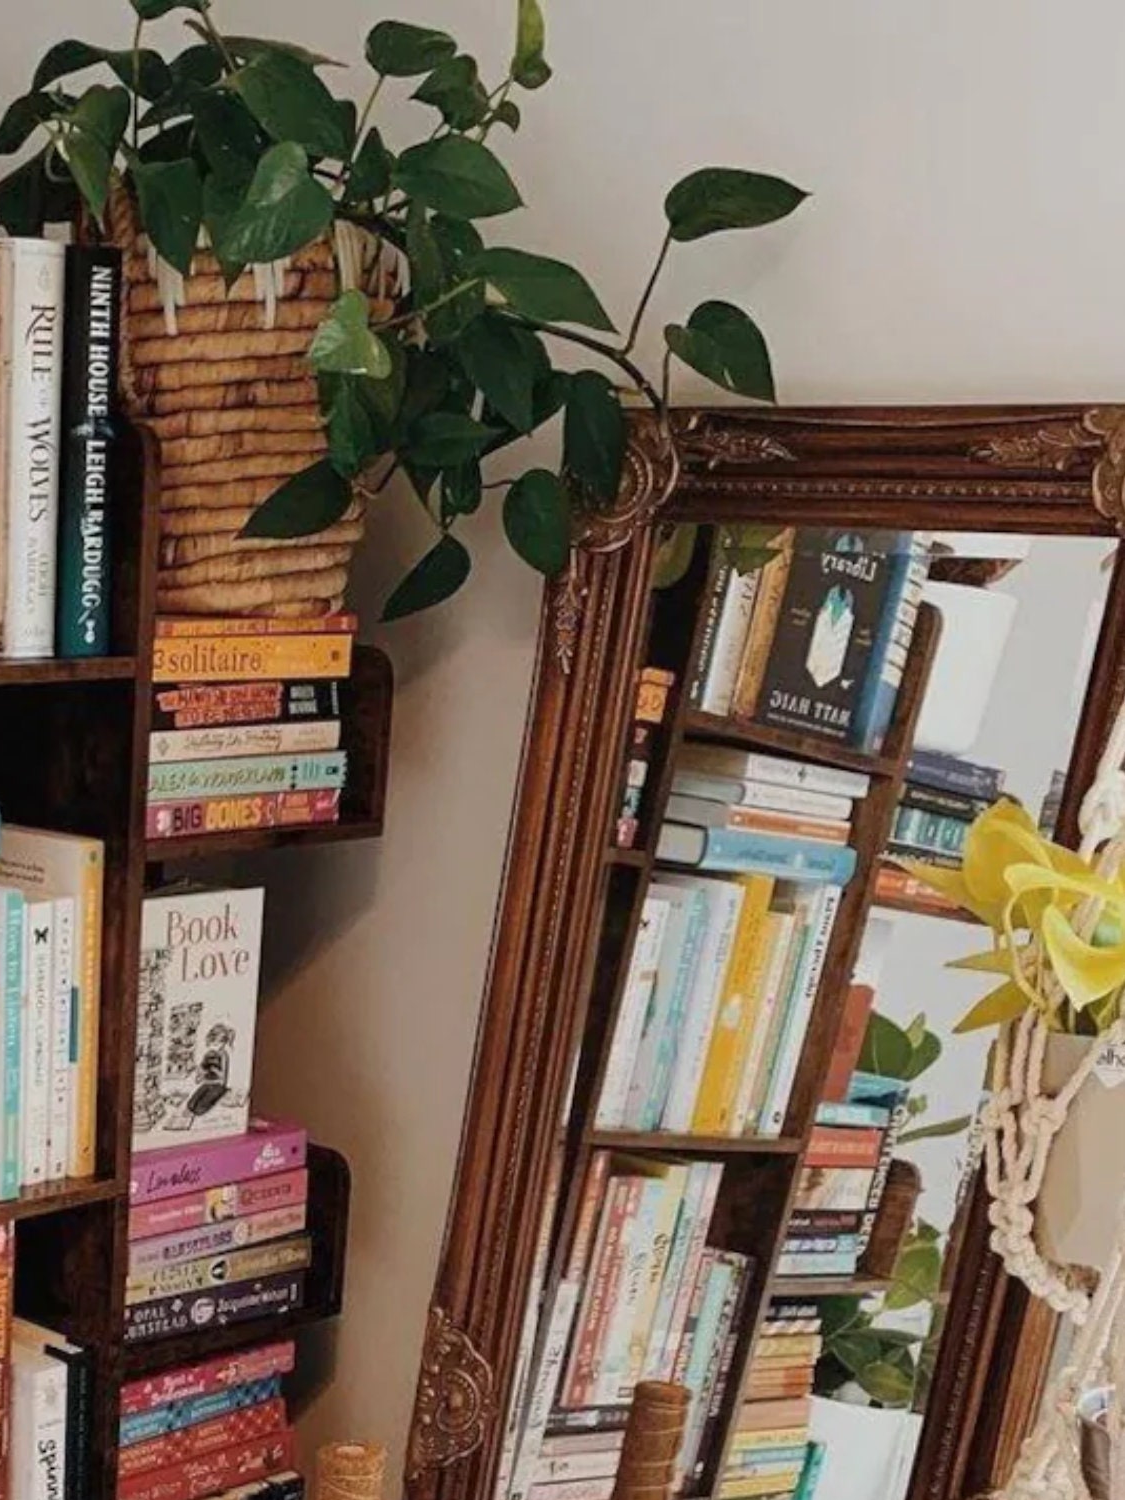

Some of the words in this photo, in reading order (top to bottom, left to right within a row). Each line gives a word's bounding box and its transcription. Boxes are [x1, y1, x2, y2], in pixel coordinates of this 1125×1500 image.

[89, 264, 113, 338] NINTH
[25, 304, 56, 382] RULE
[86, 344, 110, 417] HOUSE
[25, 416, 54, 522] WOLVES
[84, 439, 106, 504] LEIGH
[80, 509, 106, 608] BARDUGO
[168, 641, 263, 674] solitaire
[166, 903, 238, 949] Book
[181, 947, 250, 983] Love
